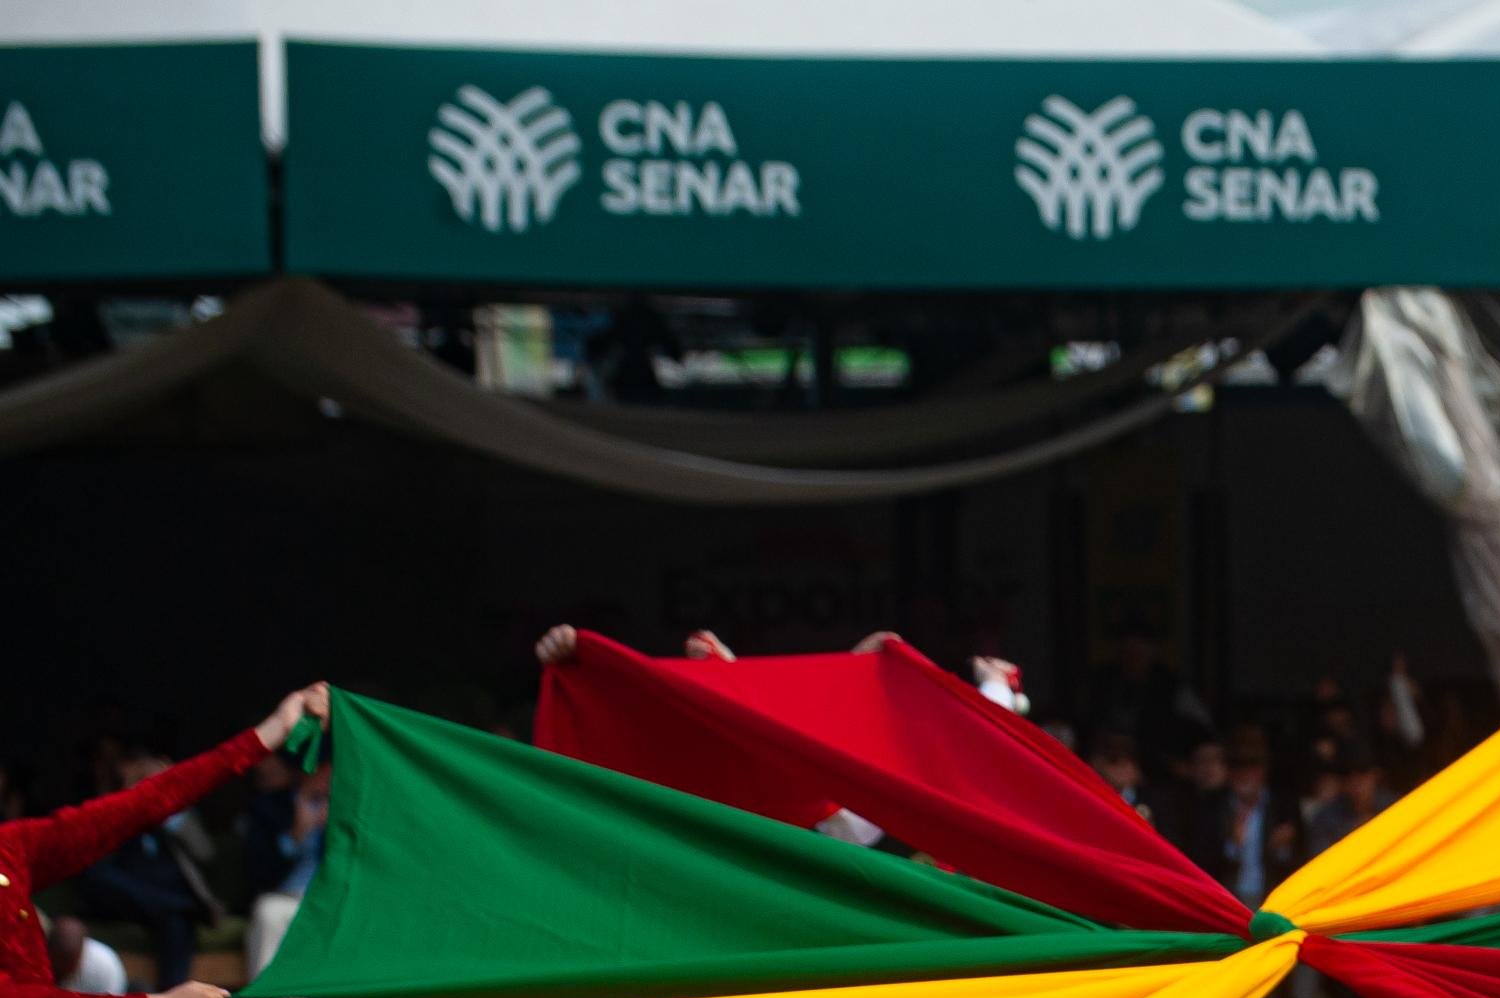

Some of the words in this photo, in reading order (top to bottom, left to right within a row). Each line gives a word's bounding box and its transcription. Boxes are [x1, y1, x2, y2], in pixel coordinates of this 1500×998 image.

[599, 99, 737, 155] CNA
[1181, 109, 1317, 162] CNA
[601, 159, 800, 215] SENAR
[1183, 166, 1379, 221] SENAR
